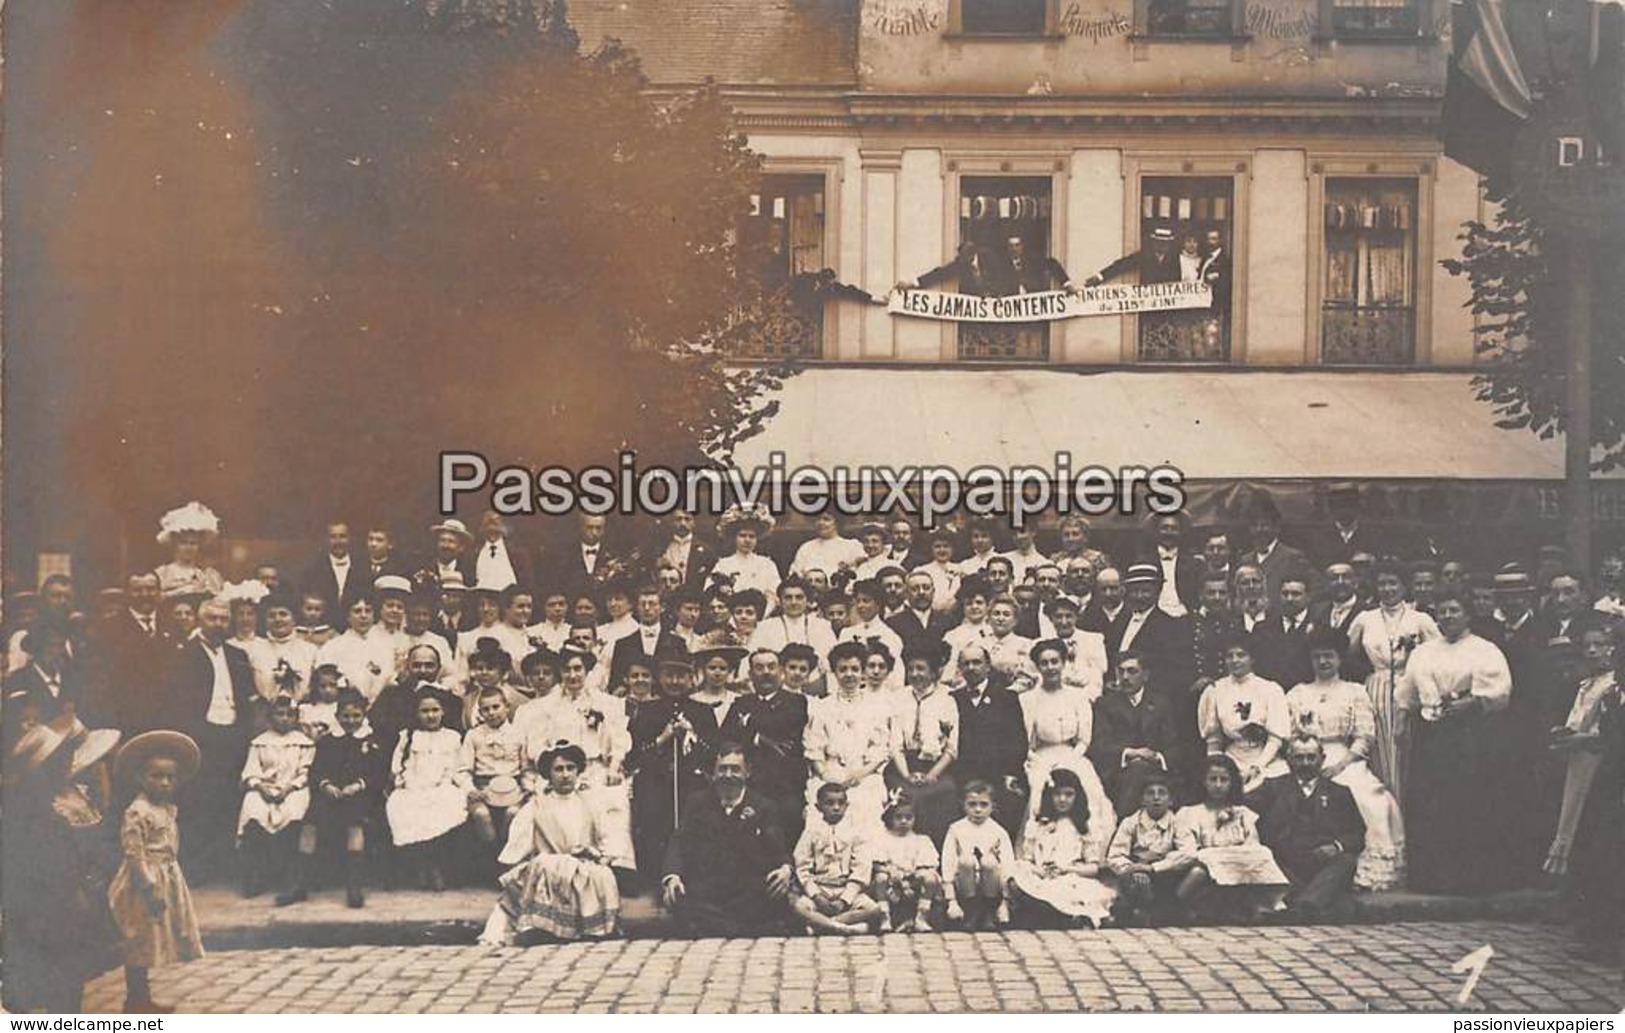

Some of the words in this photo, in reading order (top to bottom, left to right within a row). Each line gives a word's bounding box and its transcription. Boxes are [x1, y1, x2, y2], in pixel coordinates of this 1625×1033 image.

[903, 290, 930, 313] LES
[932, 294, 988, 318] JAMAIS
[992, 292, 1067, 318] CONTENTS
[1451, 944, 1495, 1004] 1
